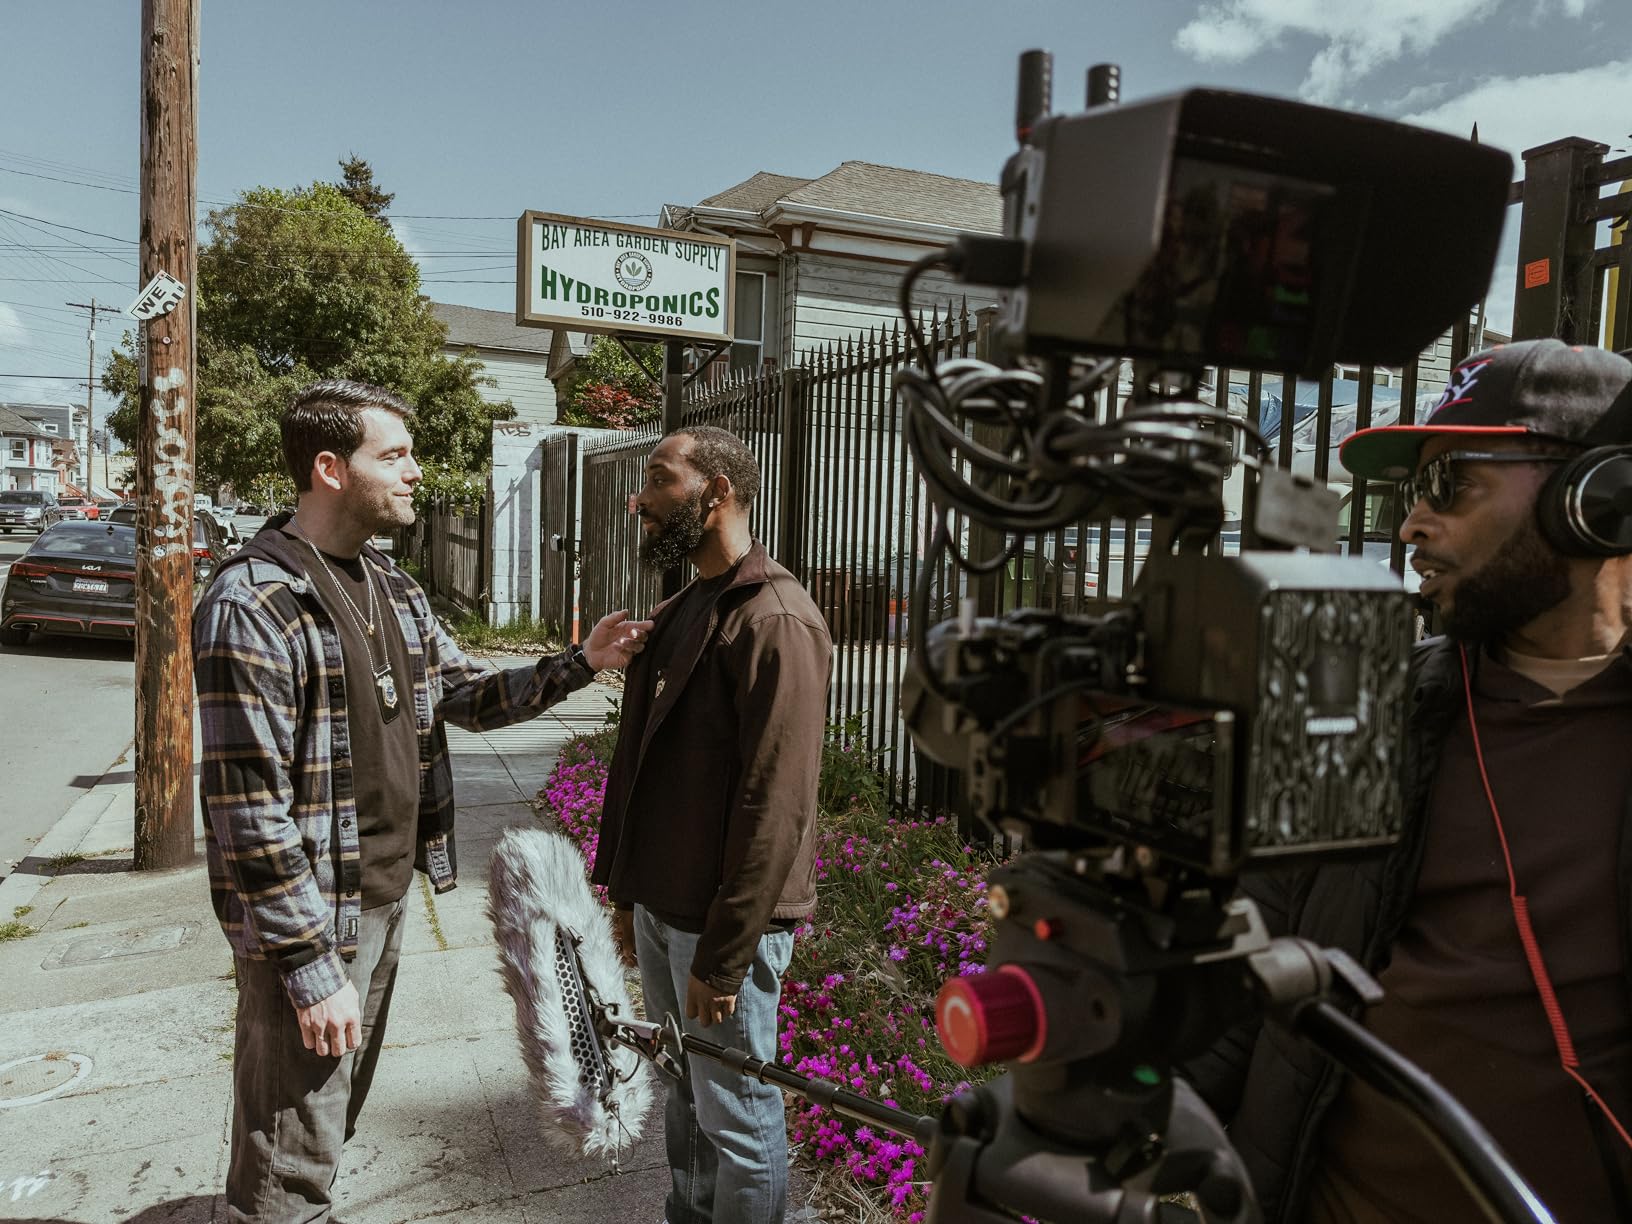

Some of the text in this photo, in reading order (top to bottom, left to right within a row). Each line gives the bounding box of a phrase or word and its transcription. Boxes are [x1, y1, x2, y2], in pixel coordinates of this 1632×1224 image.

[542, 223, 721, 273] BAY AREA GARDEN SUPPLY
[137, 286, 167, 314] WE
[541, 264, 720, 319] HYDROPONICS
[581, 305, 683, 327] 510-922-9986
[81, 564, 102, 572] KIA
